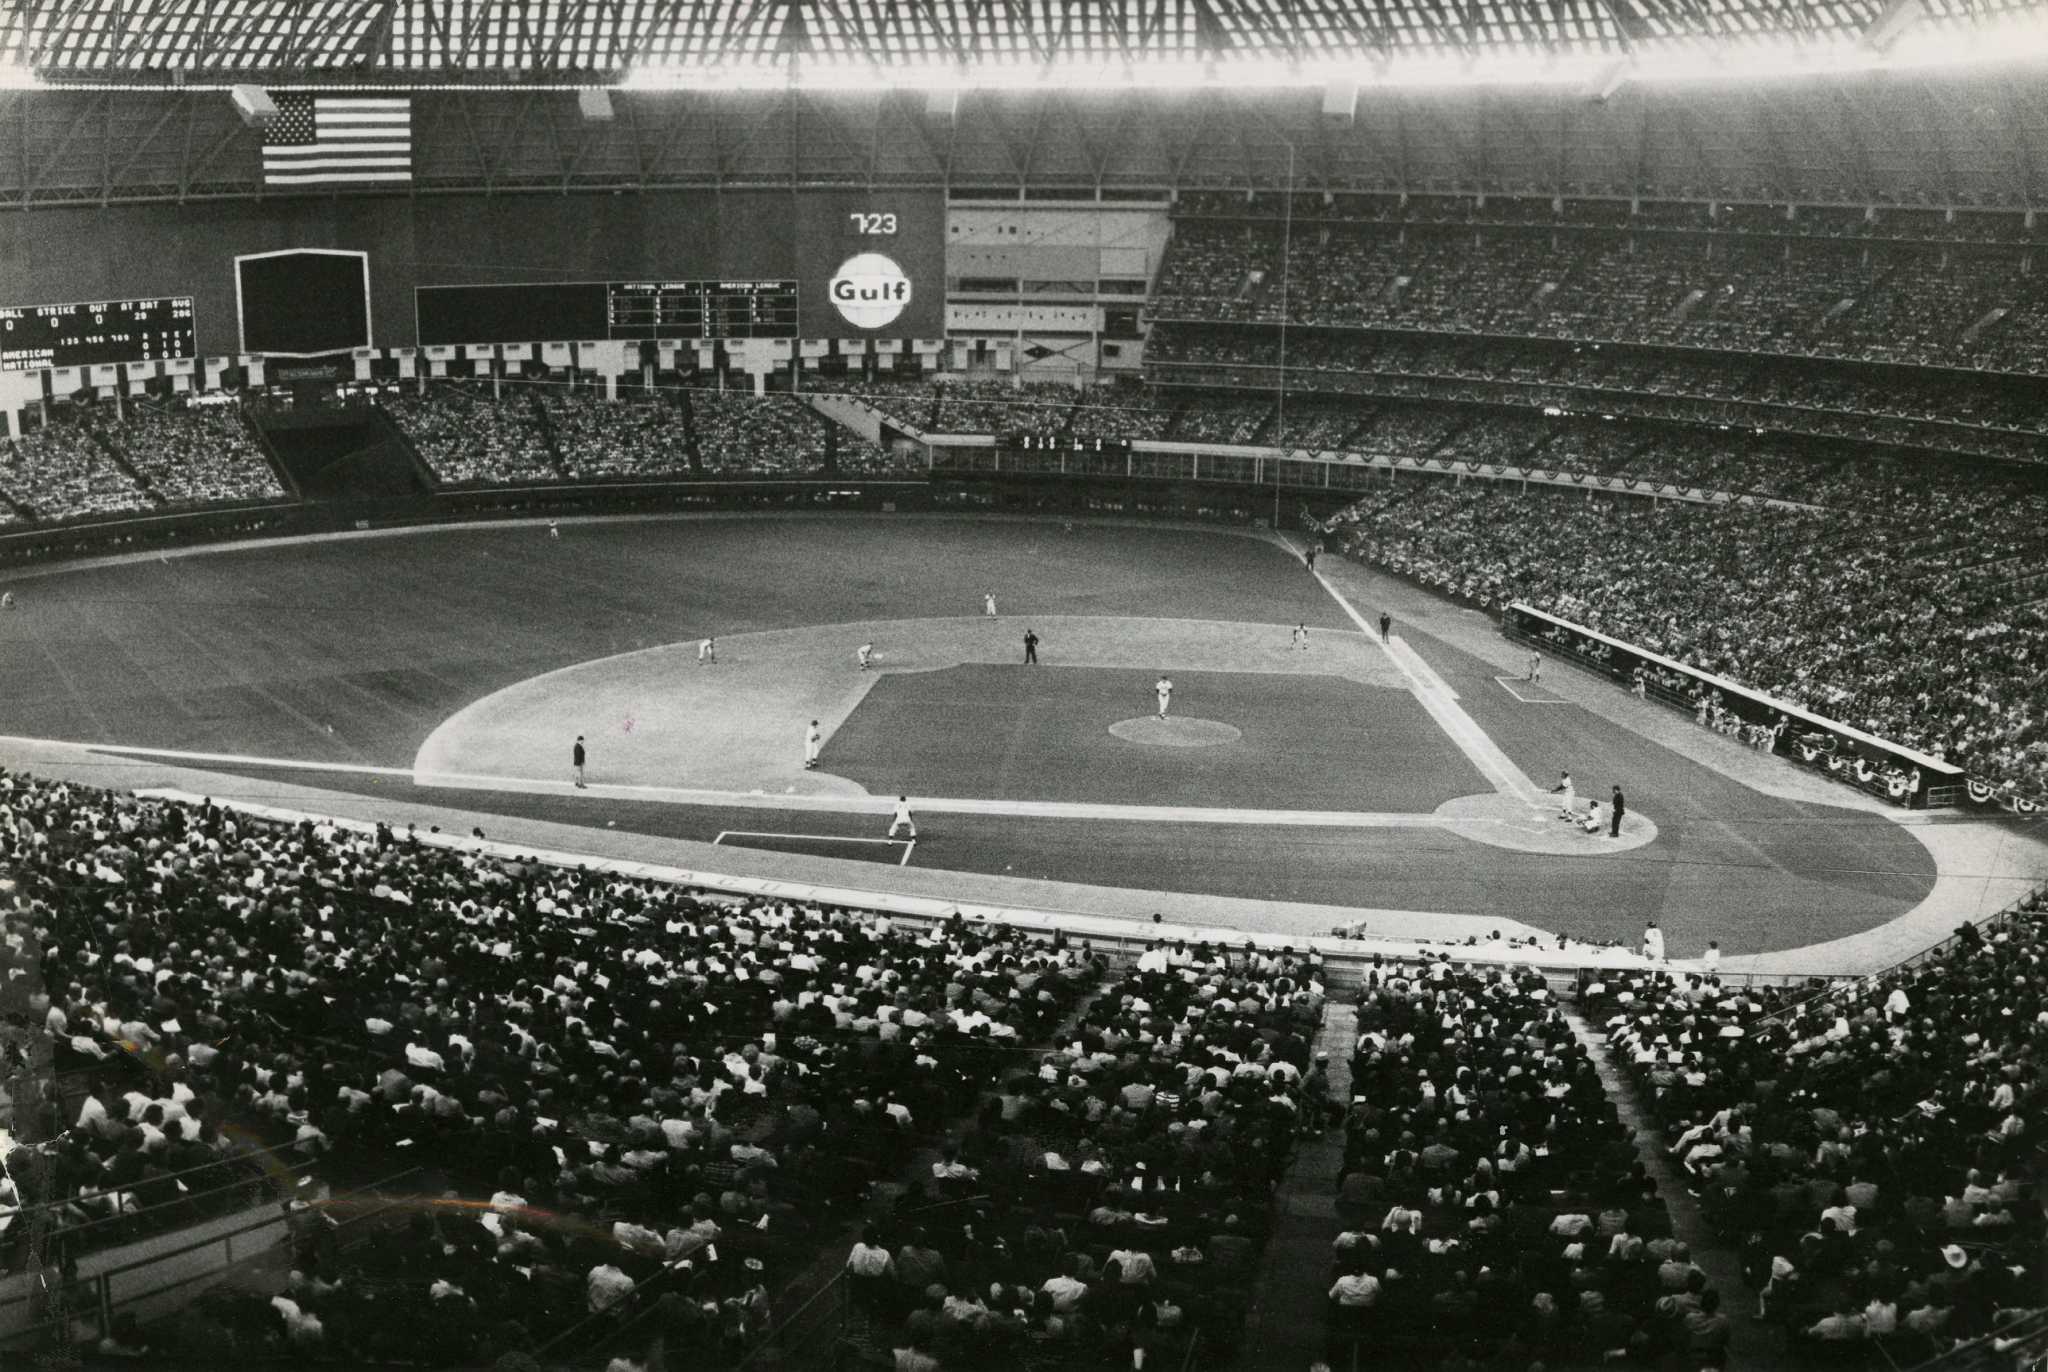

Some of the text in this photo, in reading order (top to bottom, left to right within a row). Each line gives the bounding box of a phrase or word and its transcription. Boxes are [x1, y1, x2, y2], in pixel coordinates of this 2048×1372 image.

[850, 213, 897, 234] 7:23
[834, 280, 905, 300] Gulf
[36, 305, 76, 317] STRIKE
[89, 303, 108, 313] OUT
[120, 302, 133, 311] AT
[140, 300, 159, 310] BAT
[172, 299, 190, 308] AVG
[6, 320, 14, 331] 0
[50, 317, 59, 328] 0
[95, 314, 103, 325] 0
[2, 339, 181, 360] AMERICAN 0 1 0
[3, 349, 181, 370] NATIONAL 0 0 0
